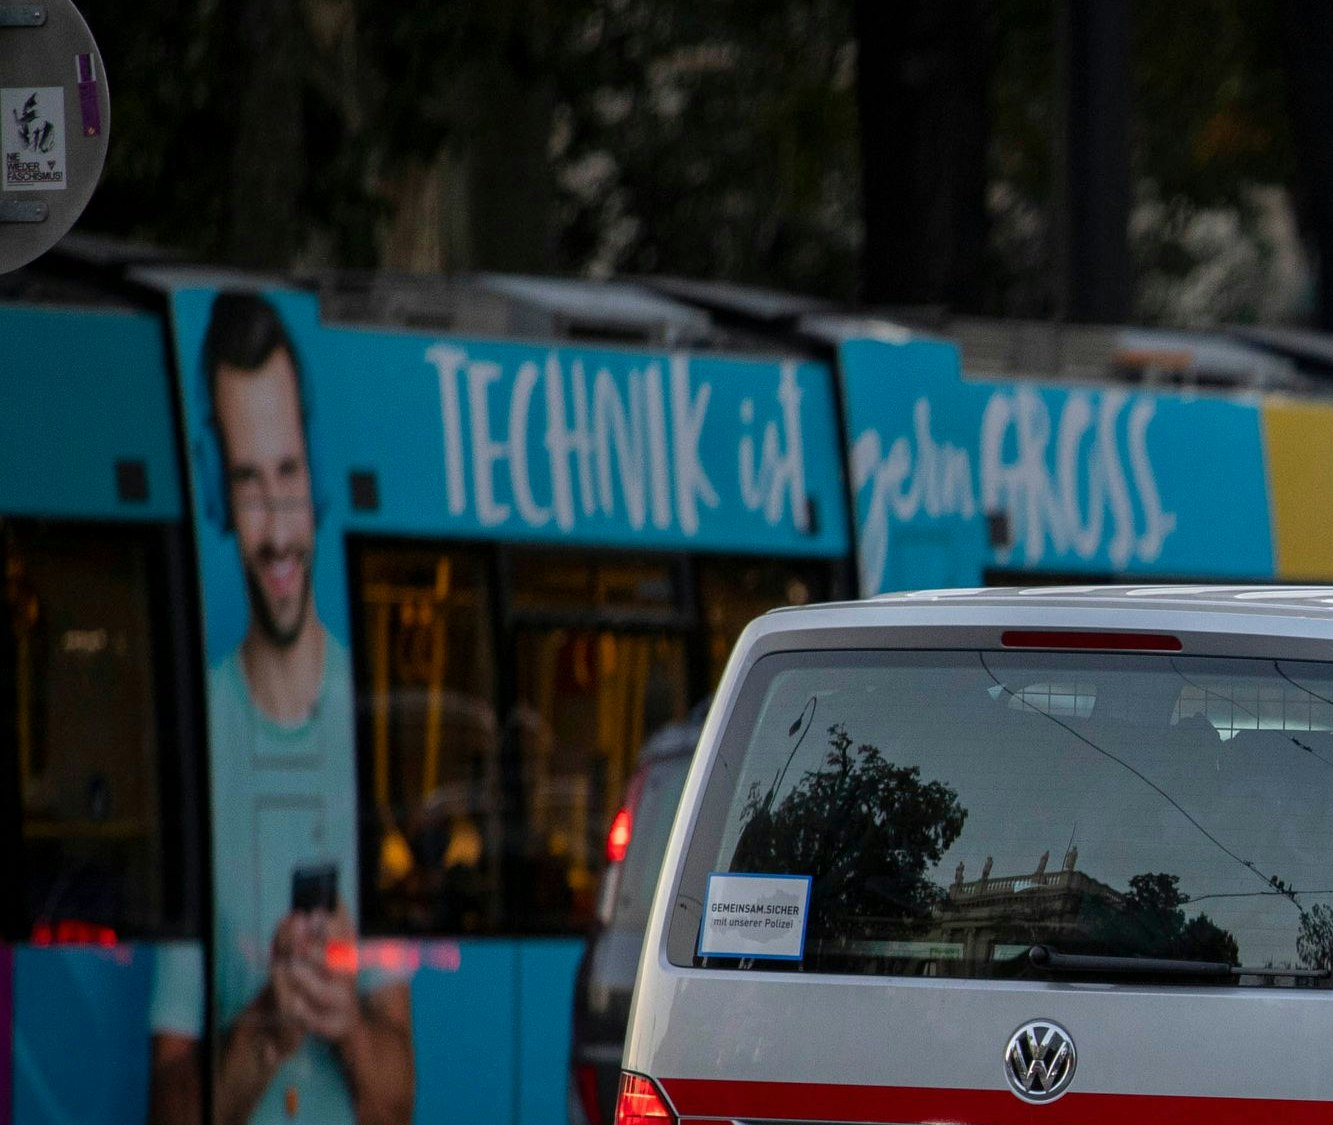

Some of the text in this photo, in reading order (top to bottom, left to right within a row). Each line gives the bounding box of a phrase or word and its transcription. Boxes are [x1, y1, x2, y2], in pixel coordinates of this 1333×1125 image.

[7, 161, 40, 171] WIEDER
[425, 344, 719, 536] TECHNIK
[738, 356, 810, 535] ist
[711, 902, 800, 916] GEMEINSAM.SICHER
[713, 918, 794, 929] mit unserer Polizei
